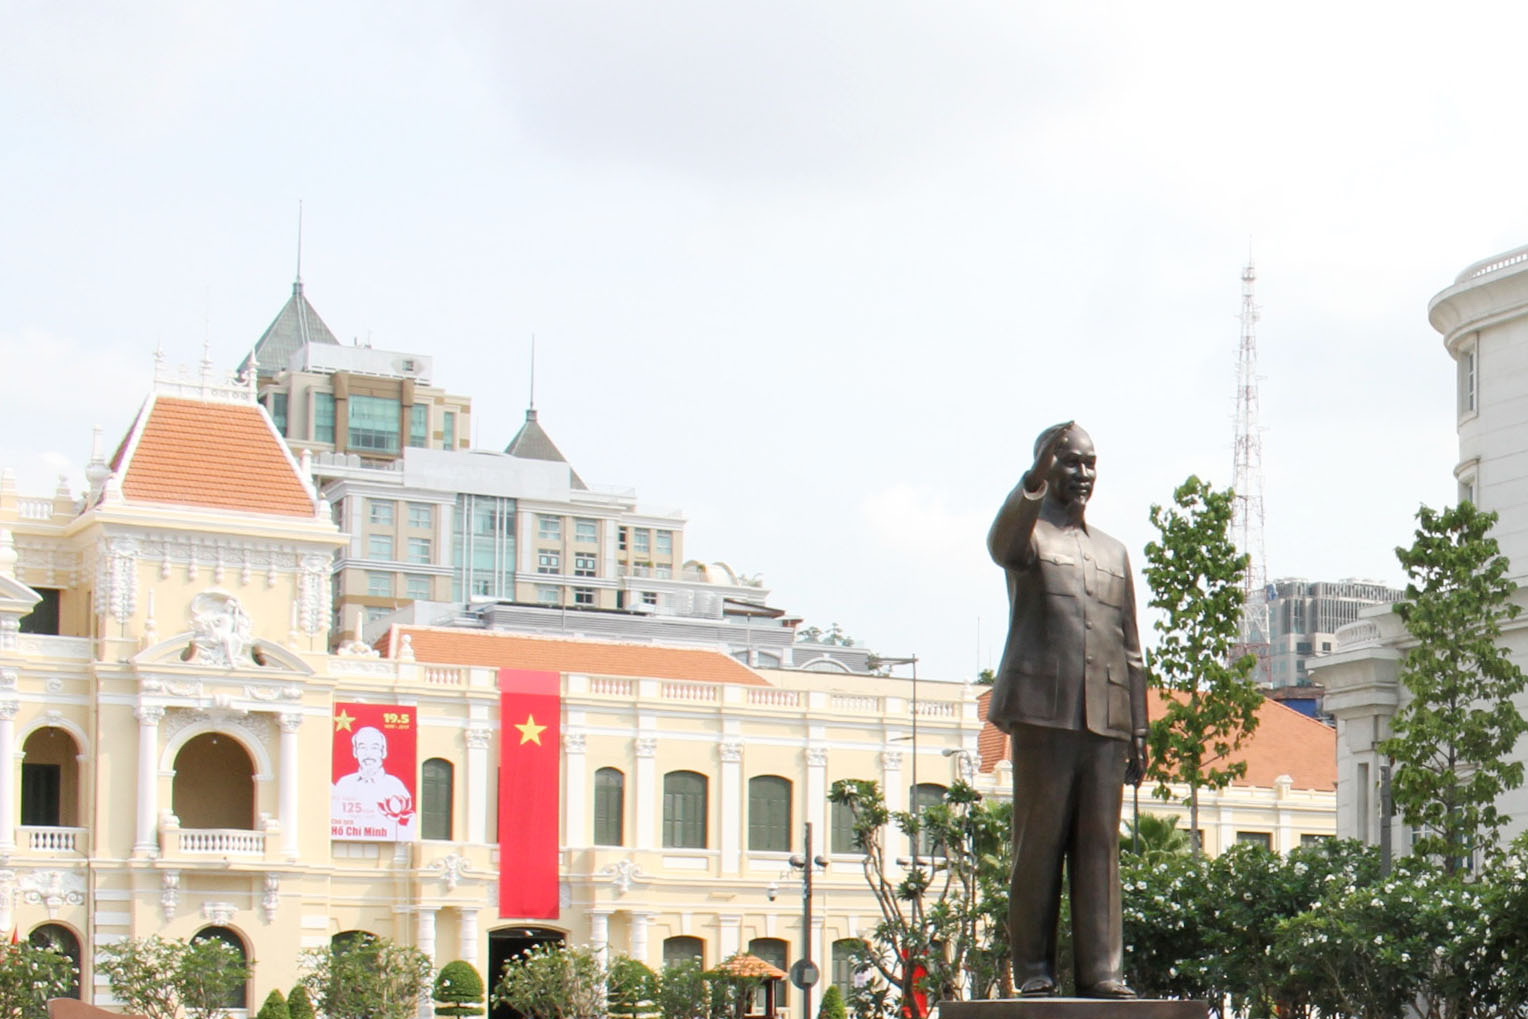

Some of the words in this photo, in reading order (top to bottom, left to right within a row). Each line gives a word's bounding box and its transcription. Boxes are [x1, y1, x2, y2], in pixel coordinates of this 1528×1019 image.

[384, 713, 410, 724] 19.5
[342, 802, 362, 813] 125
[364, 827, 388, 837] Minh
